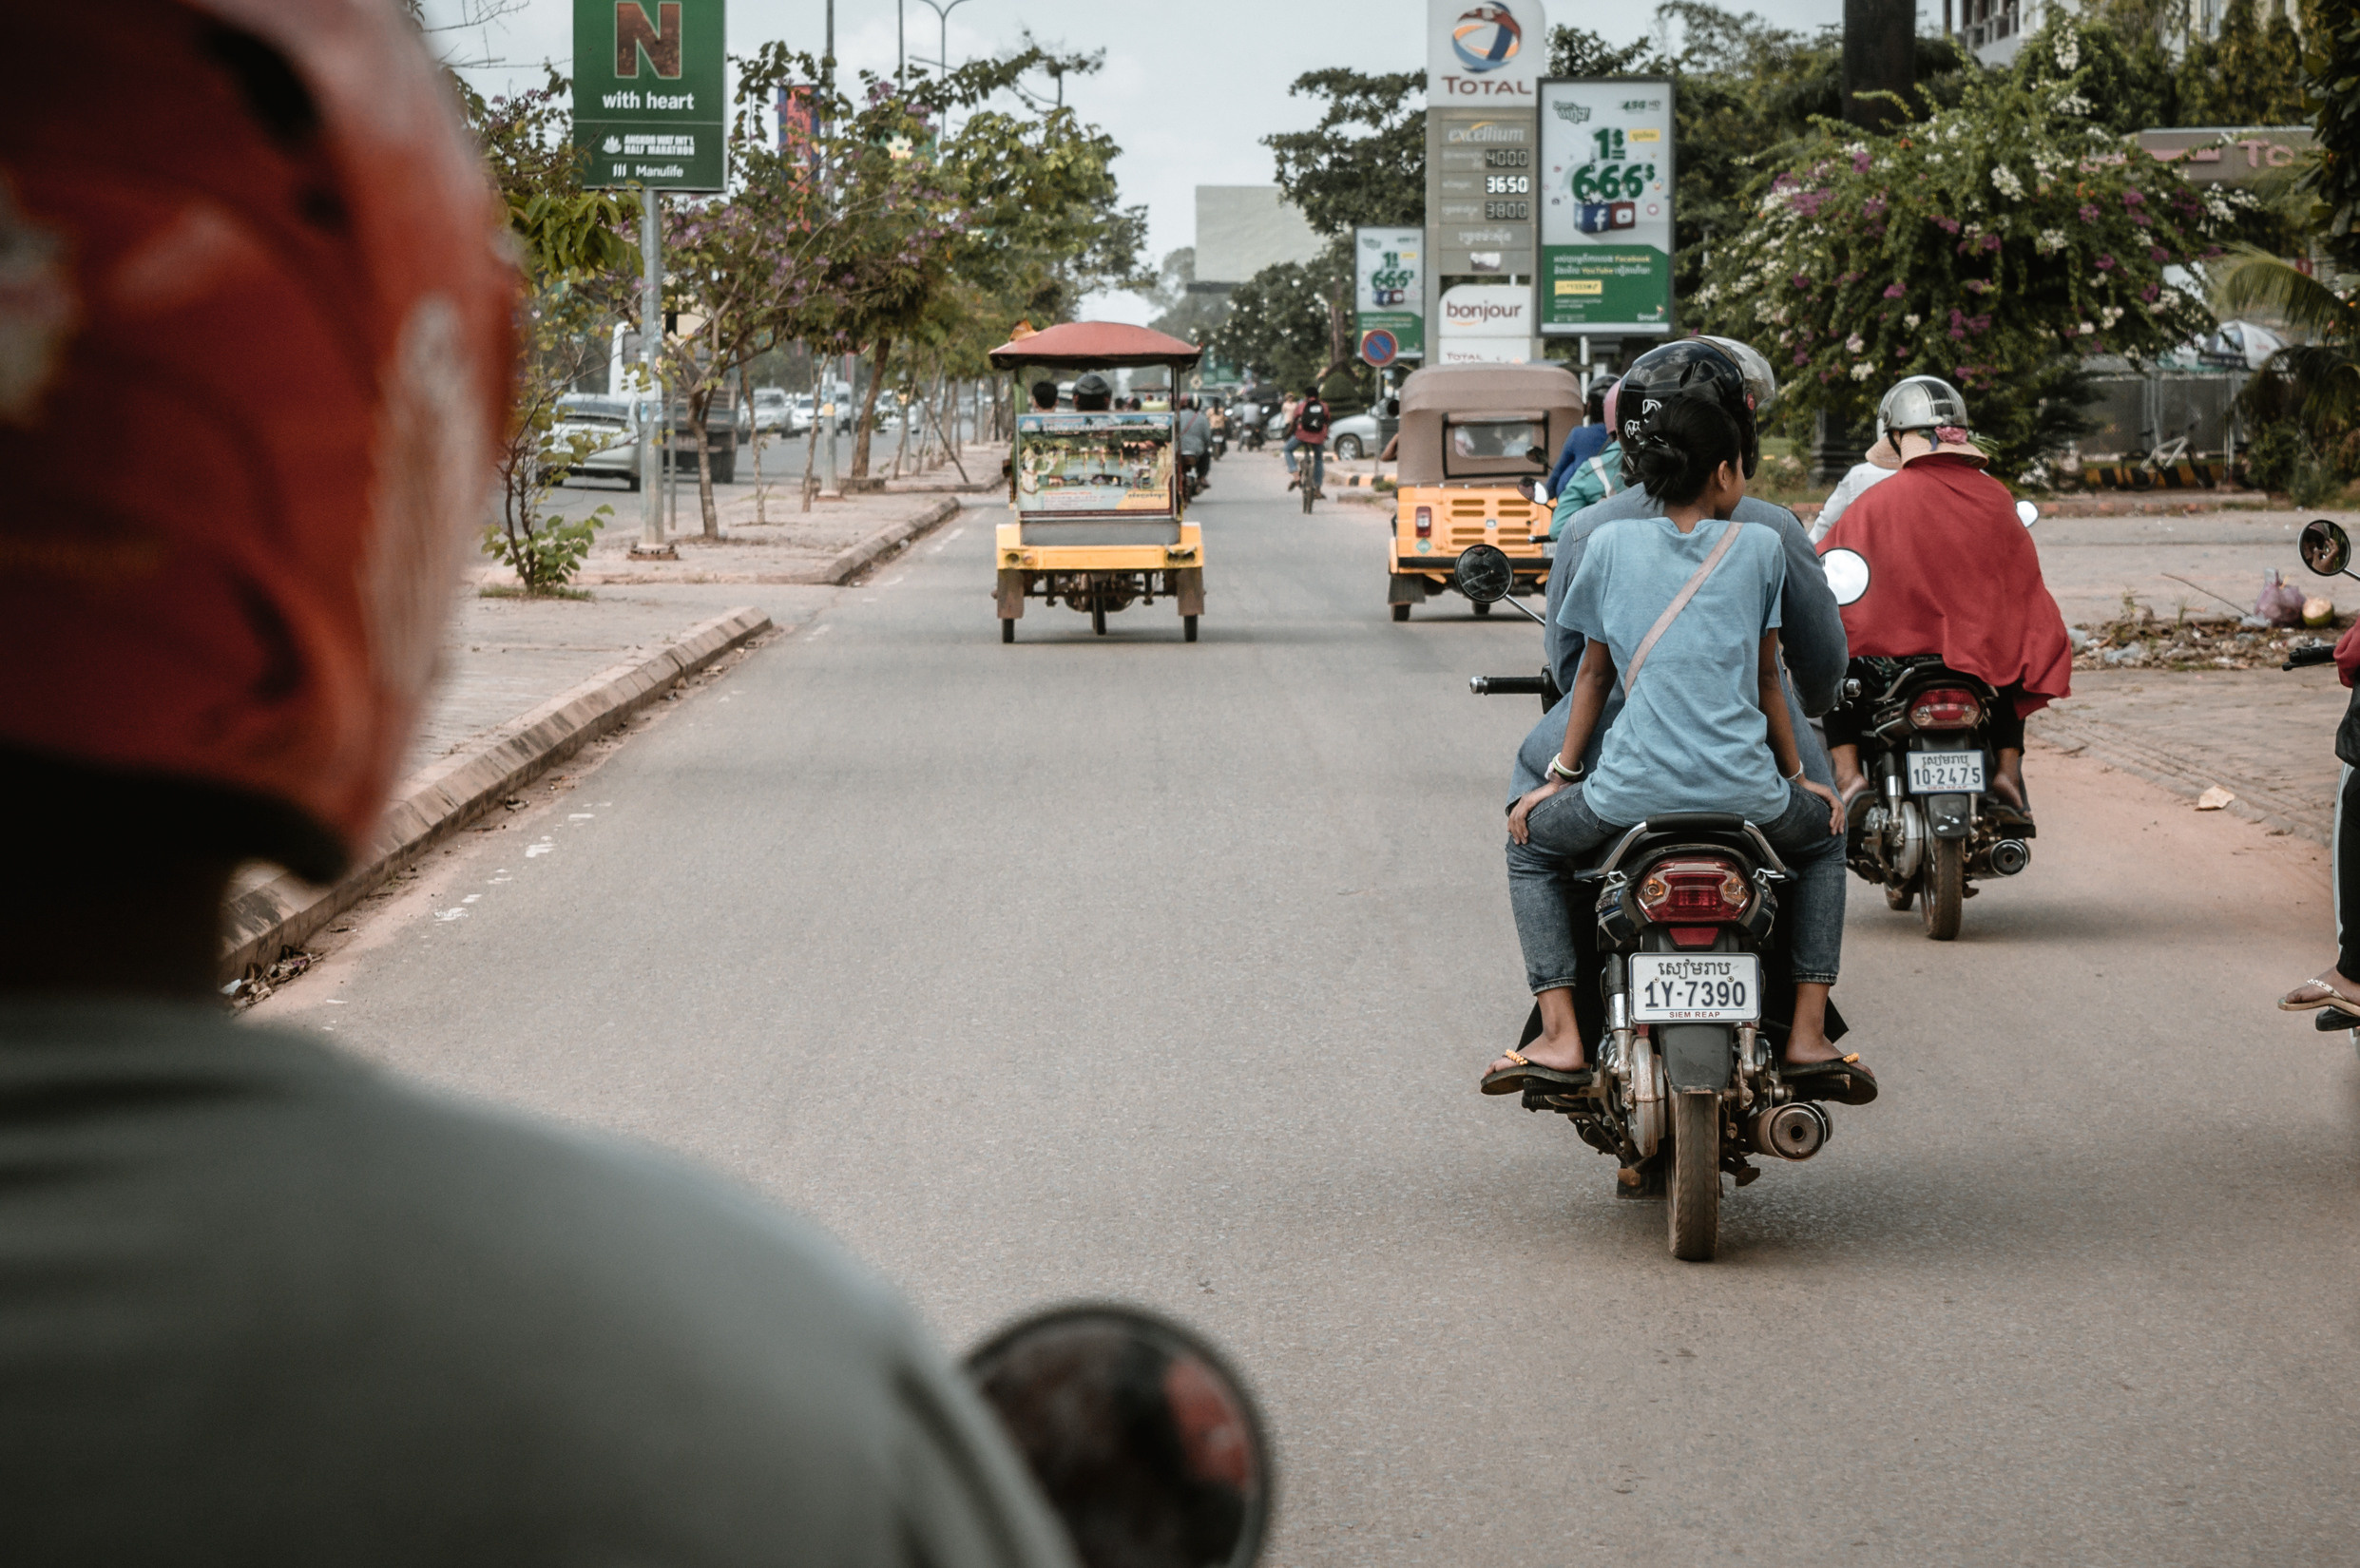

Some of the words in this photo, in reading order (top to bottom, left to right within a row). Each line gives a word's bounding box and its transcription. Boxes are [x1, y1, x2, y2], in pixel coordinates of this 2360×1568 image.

[615, 1, 682, 79] N
[1441, 76, 1532, 95] TOTAL
[602, 90, 641, 109] with
[646, 90, 695, 110] heart
[1449, 124, 1525, 143] excellium
[624, 145, 644, 155] HALF
[647, 145, 695, 156] MARATHON
[1486, 150, 1527, 166] 4000
[635, 164, 684, 178] Manulife
[1486, 176, 1528, 194] 3650
[1486, 202, 1527, 219] 3800
[1447, 299, 1522, 322] bonjour
[1645, 981, 1745, 1008] 1Y-7390
